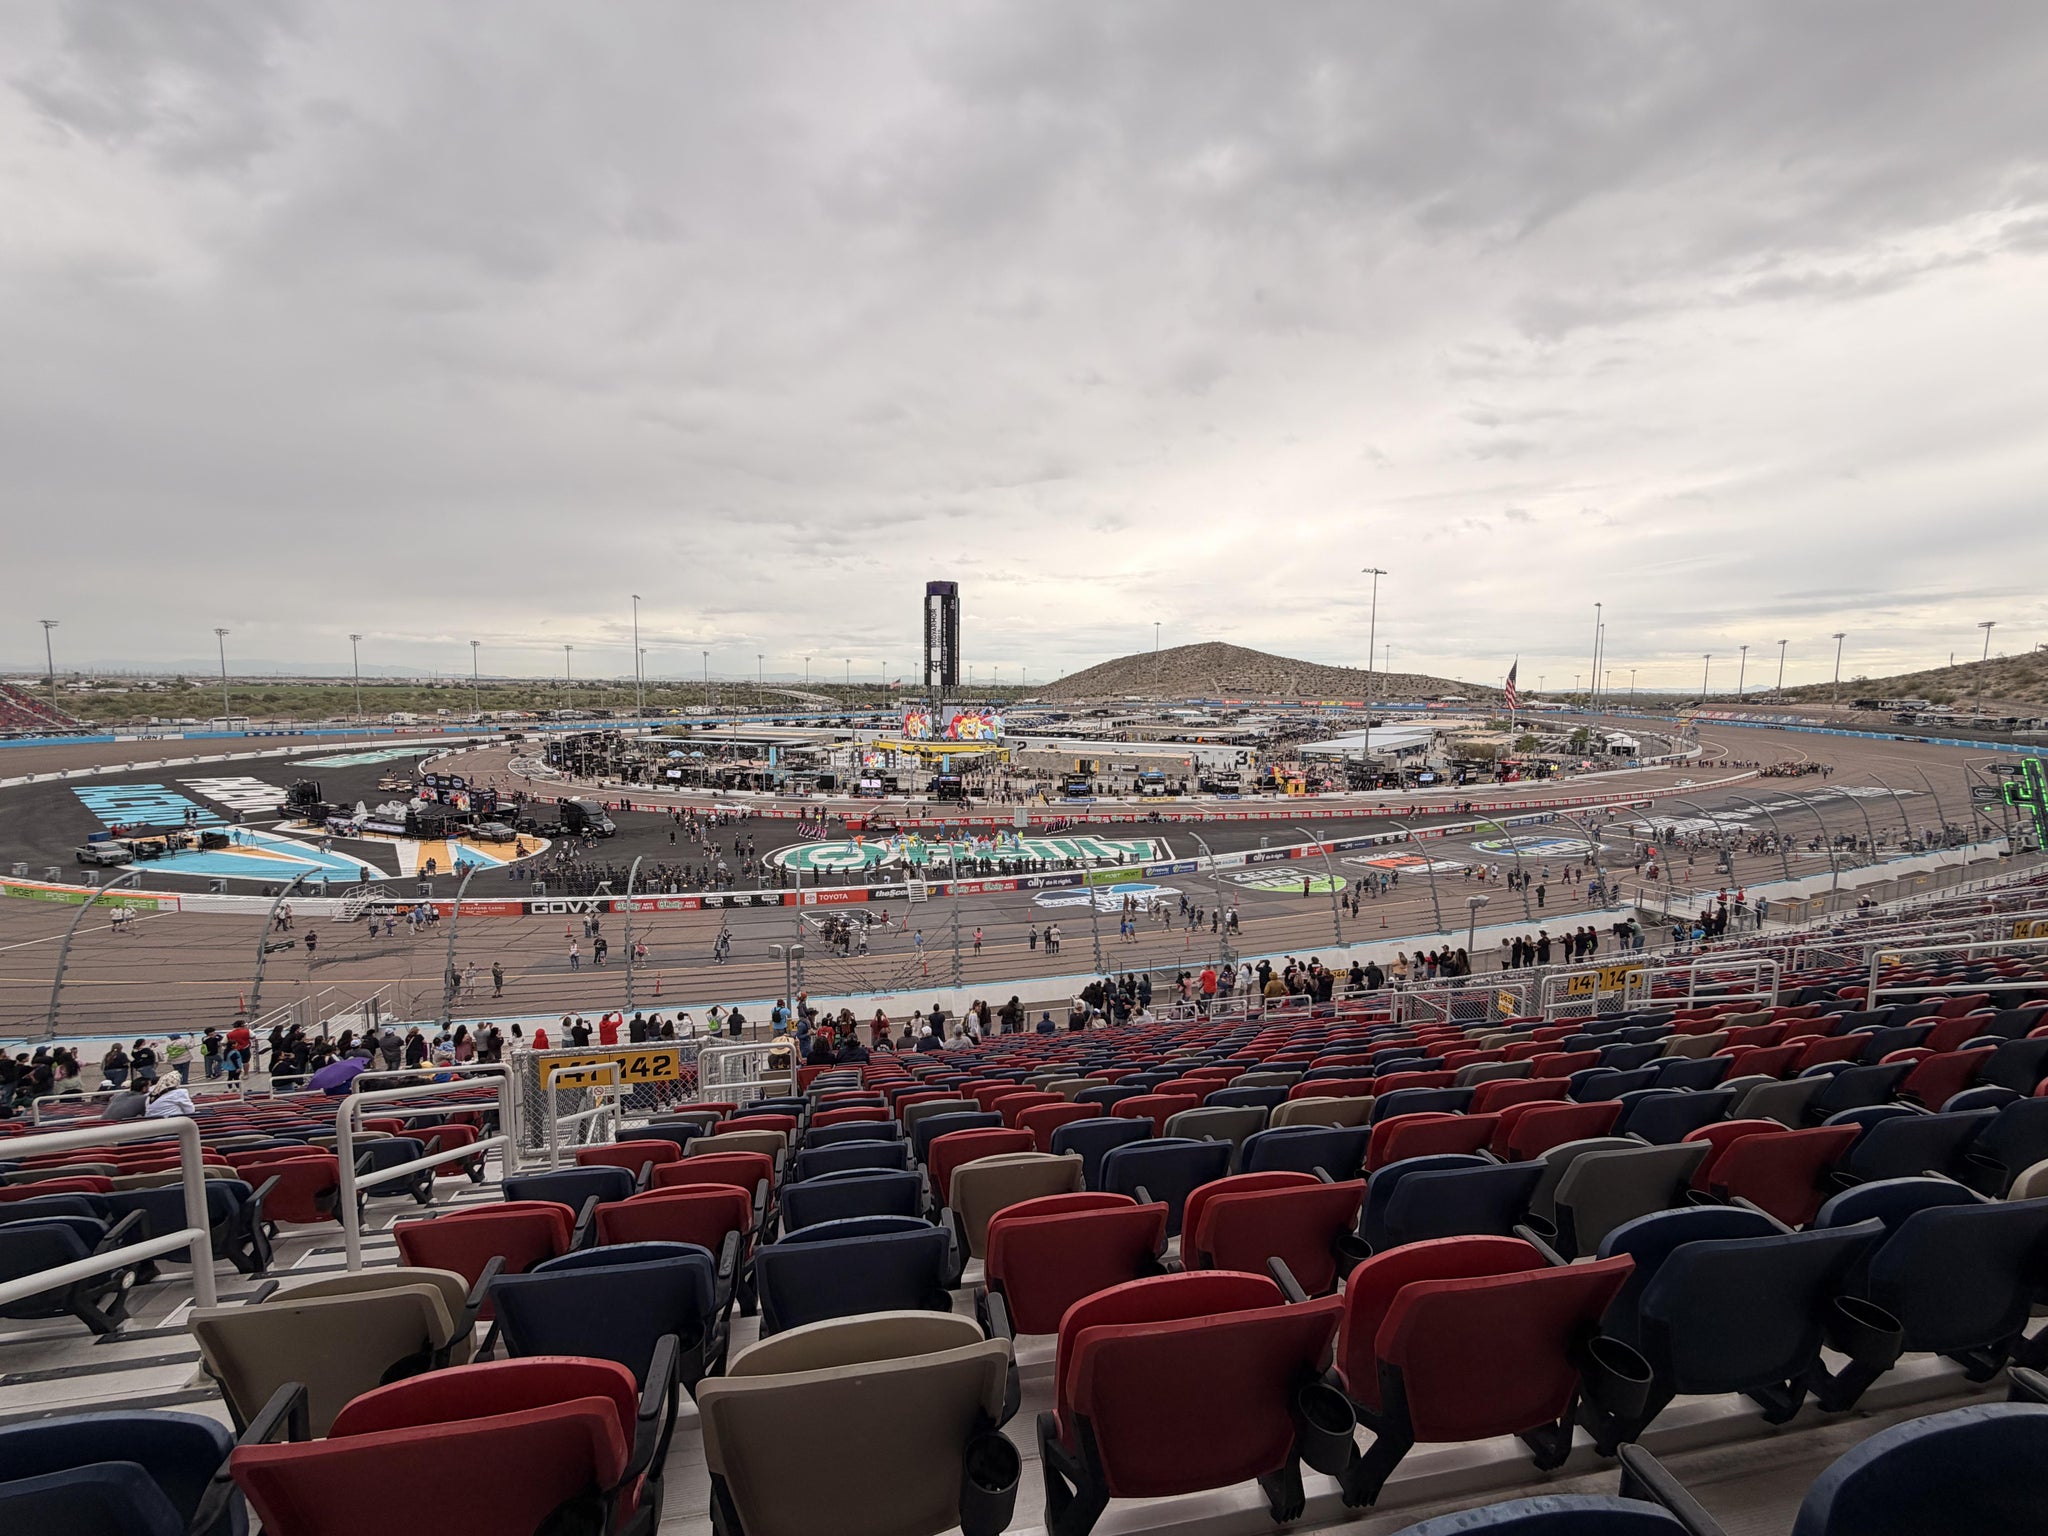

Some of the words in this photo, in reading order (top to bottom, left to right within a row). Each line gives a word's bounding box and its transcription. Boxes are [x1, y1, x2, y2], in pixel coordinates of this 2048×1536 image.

[1235, 751, 1248, 766] 3
[1027, 877, 1045, 888] ally
[12, 888, 35, 898] POET
[45, 892, 71, 902] POET
[819, 893, 848, 901] TOYOTA
[531, 902, 600, 914] GOVX
[618, 1055, 672, 1079] 142
